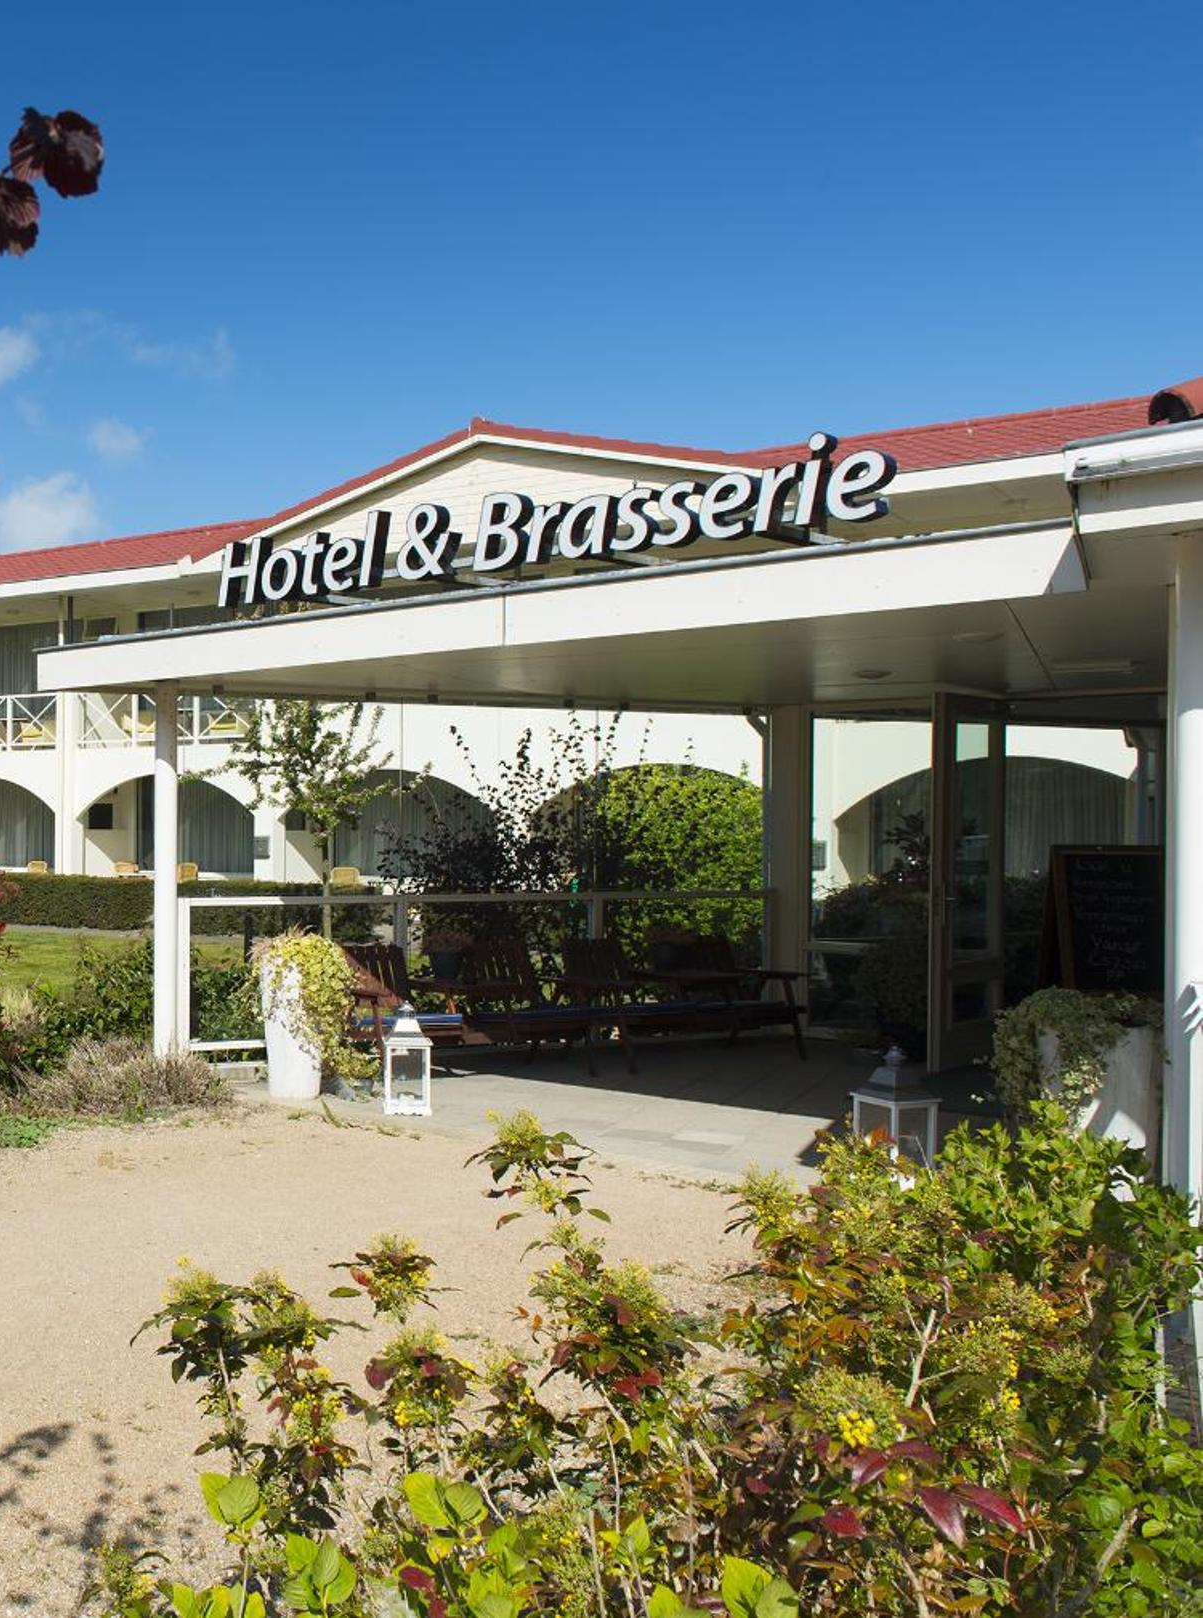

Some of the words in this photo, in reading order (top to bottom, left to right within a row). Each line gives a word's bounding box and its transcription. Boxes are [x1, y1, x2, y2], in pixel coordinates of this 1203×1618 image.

[217, 509, 391, 608] Hotel
[396, 503, 462, 582] &
[472, 431, 898, 573] Brasserie
